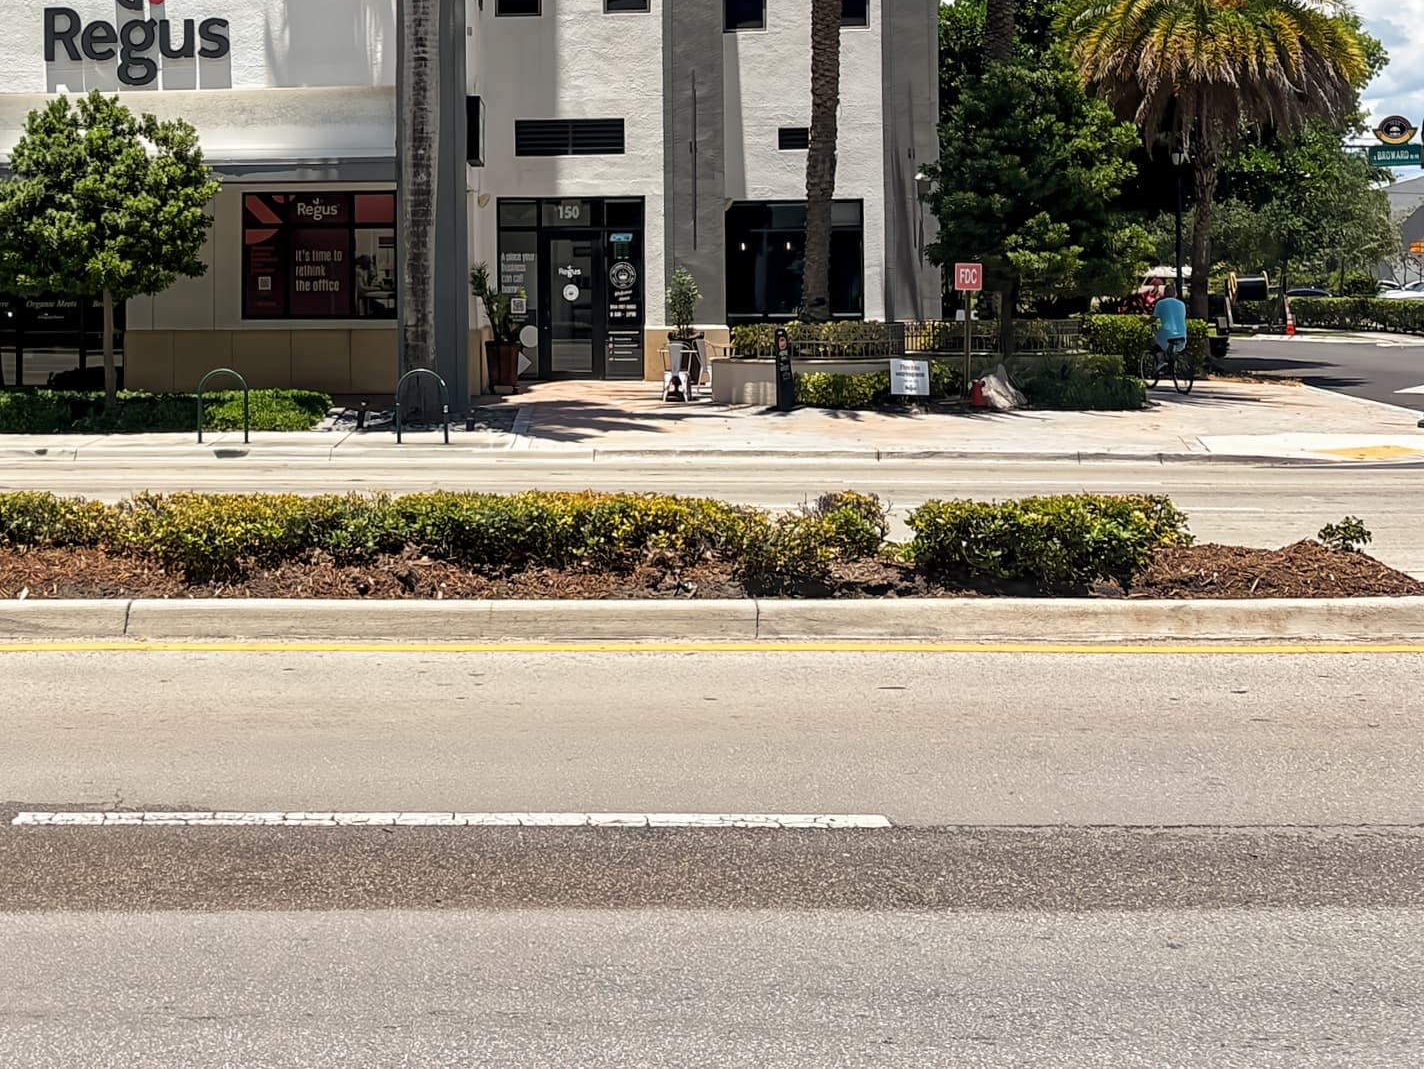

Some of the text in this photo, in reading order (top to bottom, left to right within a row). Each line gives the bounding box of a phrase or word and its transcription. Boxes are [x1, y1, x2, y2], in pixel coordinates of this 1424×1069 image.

[44, 6, 230, 86] Regus
[1376, 150, 1410, 161] BROWARD
[297, 202, 338, 221] Regus
[557, 205, 580, 220] 150
[295, 249, 311, 262] It's
[312, 249, 332, 262] time
[333, 249, 343, 262] to
[295, 264, 326, 277] rethink
[959, 268, 978, 285] FDC
[295, 279, 341, 292] the office
